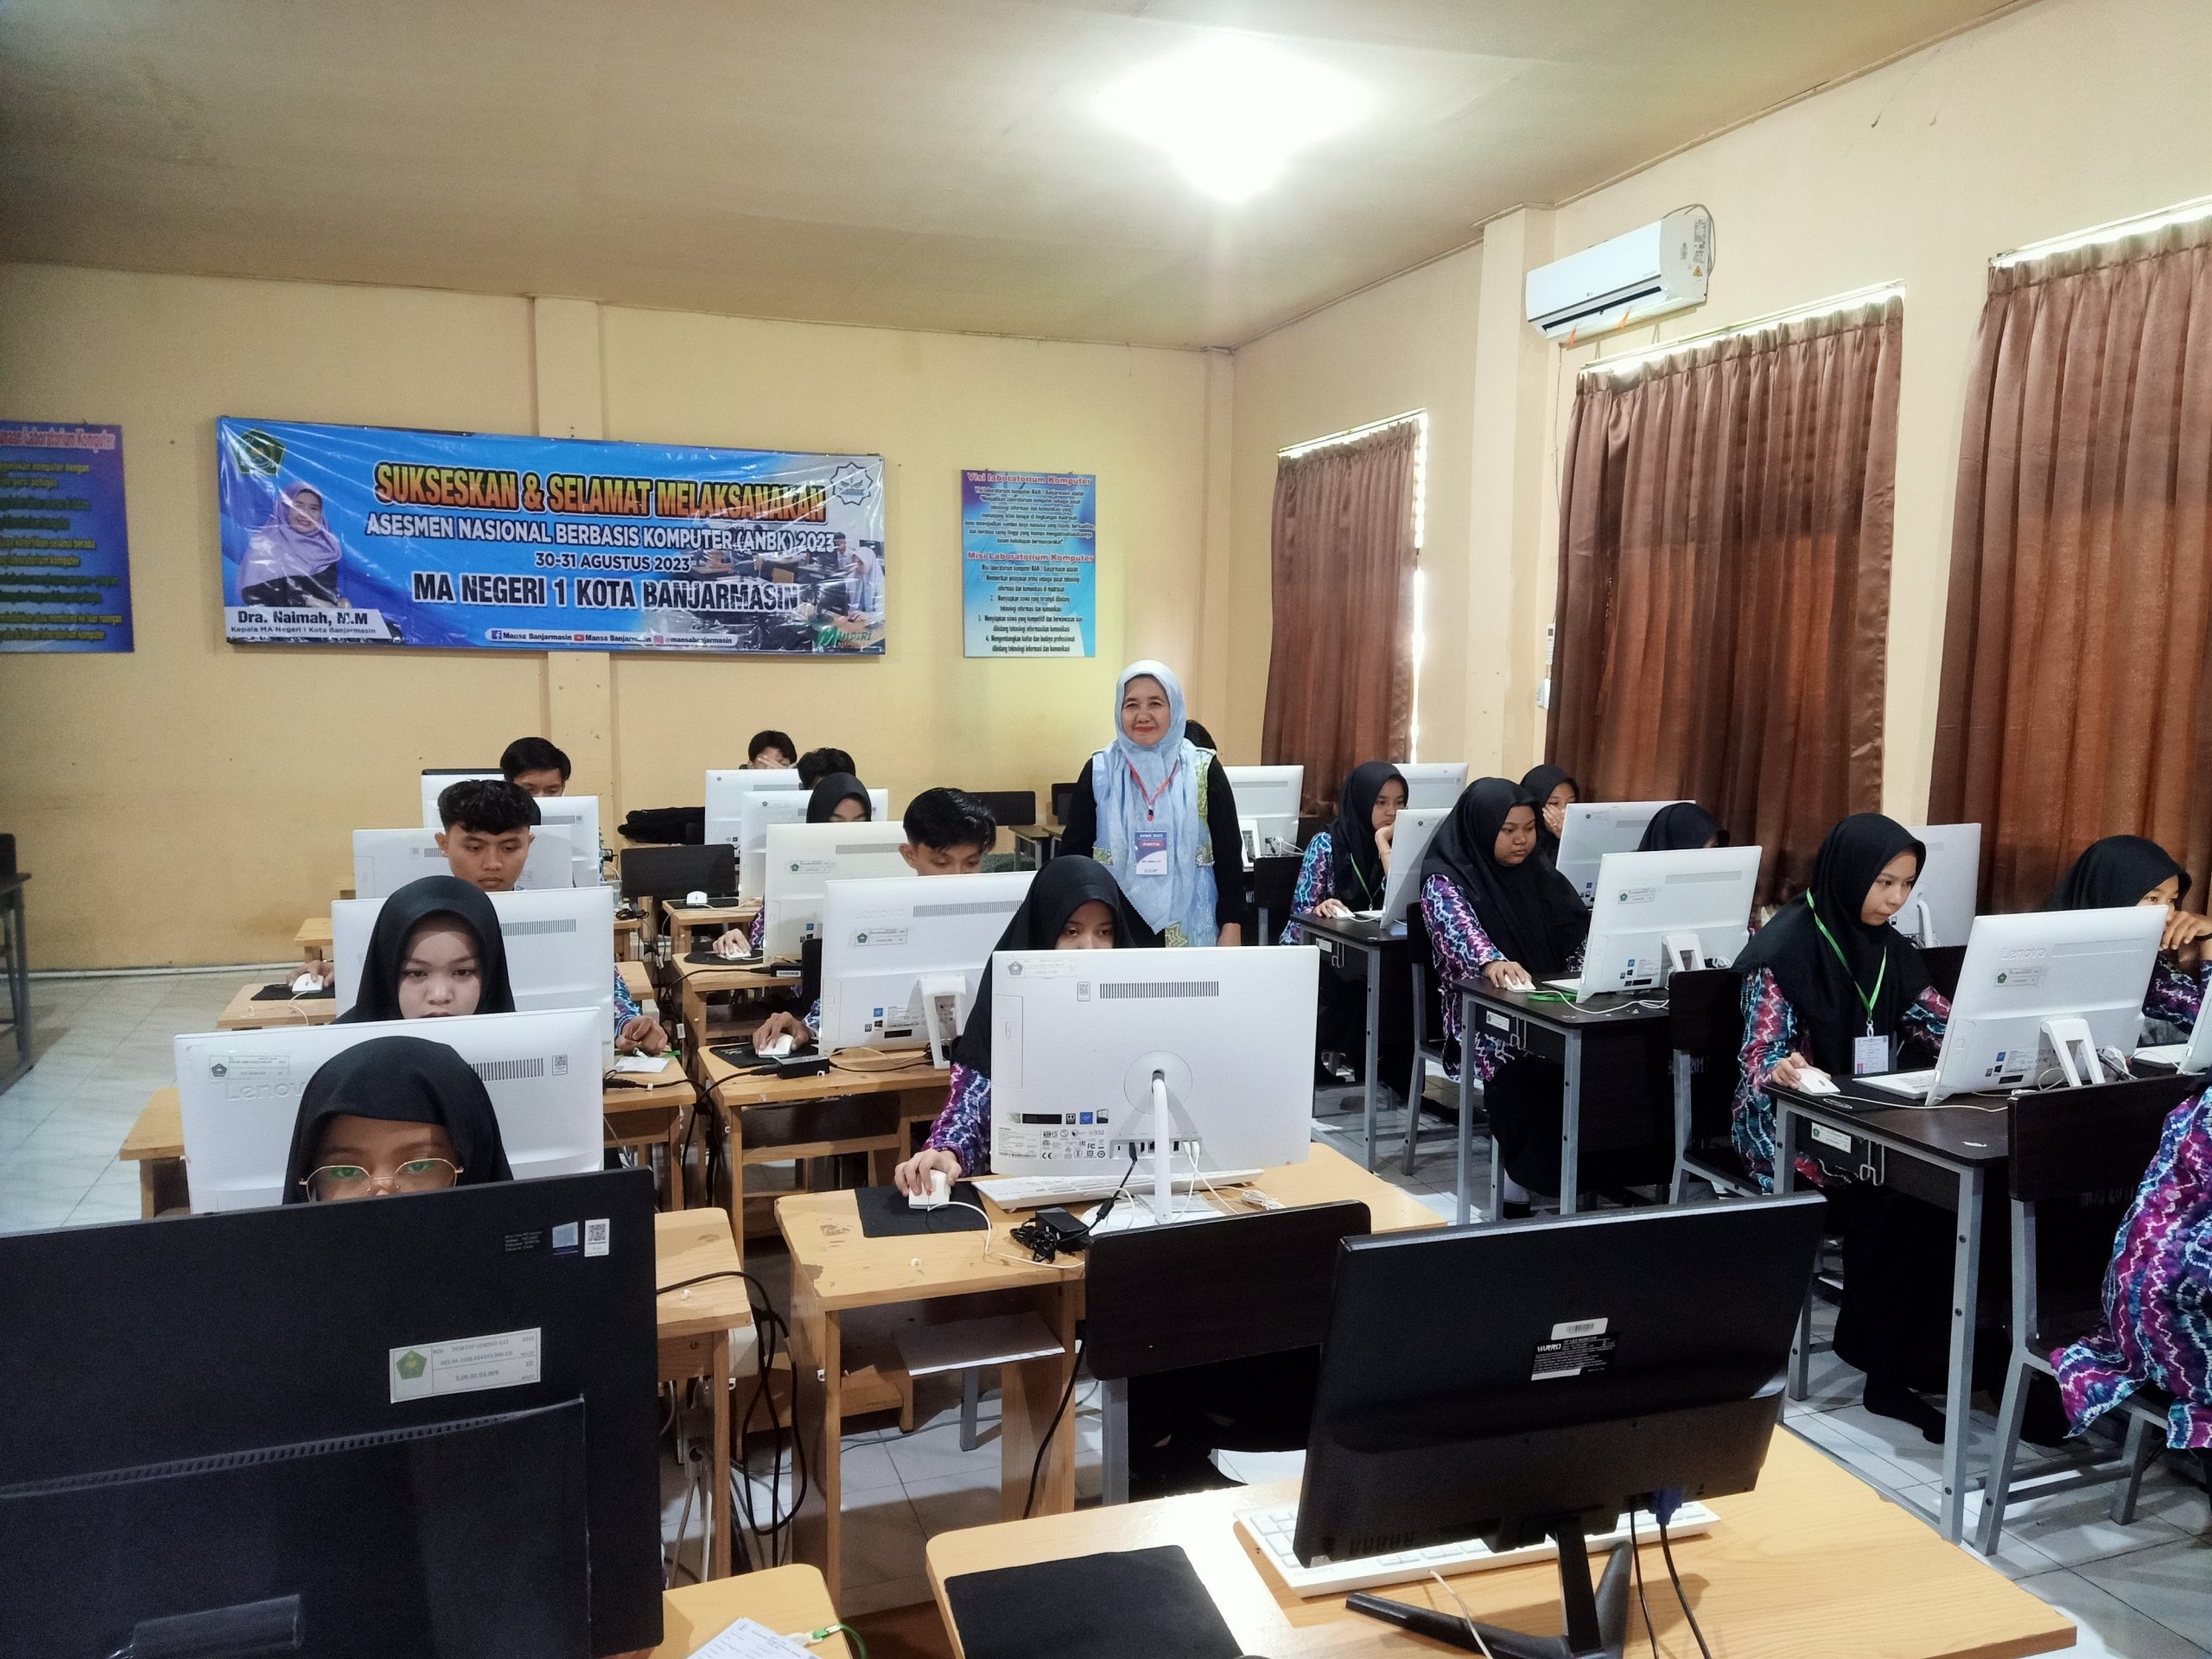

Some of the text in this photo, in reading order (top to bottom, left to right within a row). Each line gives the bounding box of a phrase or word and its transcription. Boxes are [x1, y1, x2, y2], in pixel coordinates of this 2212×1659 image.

[966, 472, 986, 482] Visi
[1047, 475, 1093, 486] Komputer
[375, 461, 827, 524] SUKSESKAN & SELAMAT MELAKSANAKAN
[366, 513, 836, 553] ASESMEN NASIONAL BERBASIS KOMPUTER (ANBK) 2023
[534, 551, 691, 572] 30-31 AGUSTUS 2023
[988, 552, 1048, 561] Laboratorium
[1051, 553, 1094, 563] Komputer
[412, 571, 800, 612] MA NEGERI 1 KOTA BANJARMASIN
[238, 610, 368, 626] Dra. Naimah, M.M
[529, 632, 572, 641] Banjarmasin
[224, 1080, 308, 1102] Lenov
